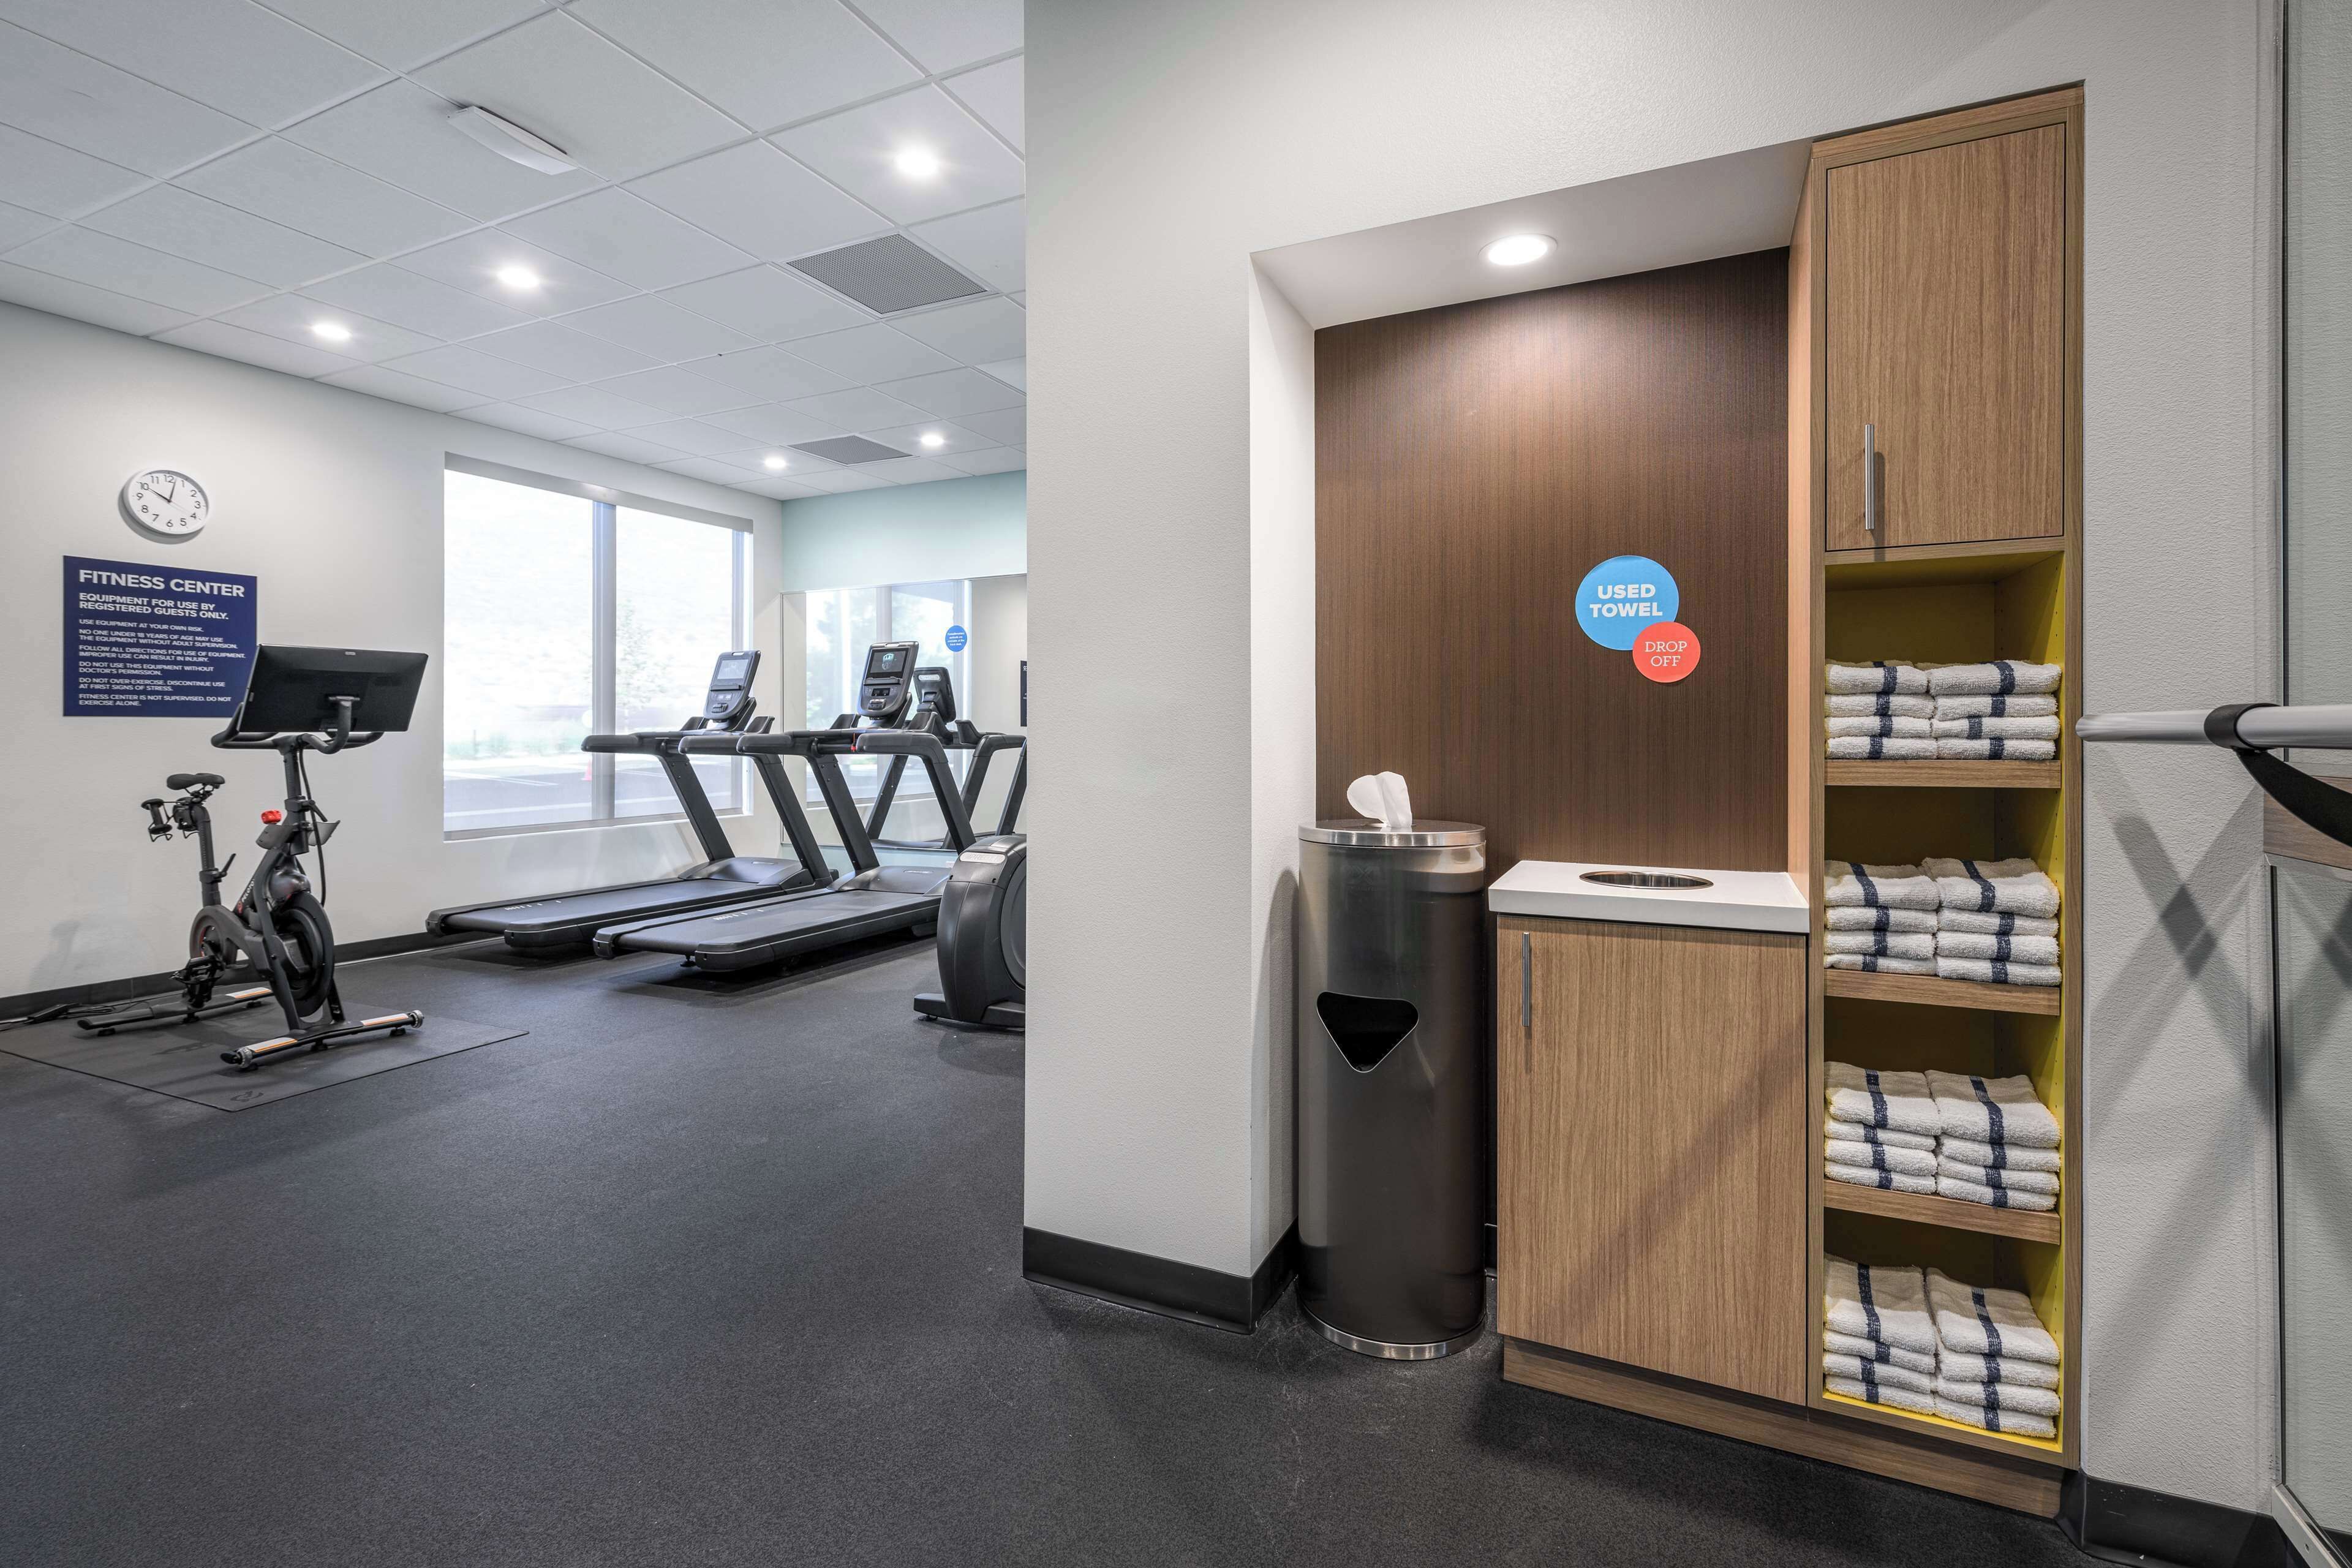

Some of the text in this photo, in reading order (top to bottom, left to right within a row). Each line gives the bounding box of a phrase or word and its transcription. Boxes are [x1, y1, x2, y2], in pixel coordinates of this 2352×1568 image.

[164, 475, 175, 483] 12
[139, 482, 149, 491] 10
[141, 505, 148, 513] 8
[152, 513, 159, 522] 7
[79, 570, 245, 597] FITNESS CENTER
[1597, 584, 1656, 599] USED
[79, 593, 149, 605] EQUIPMENT
[152, 599, 174, 608] FOR
[79, 601, 229, 620] REGISTERED GUESTS ONLY.
[1589, 602, 1662, 618] TOWEL
[1645, 641, 1688, 652] DROP
[1651, 655, 1681, 666] OFF
